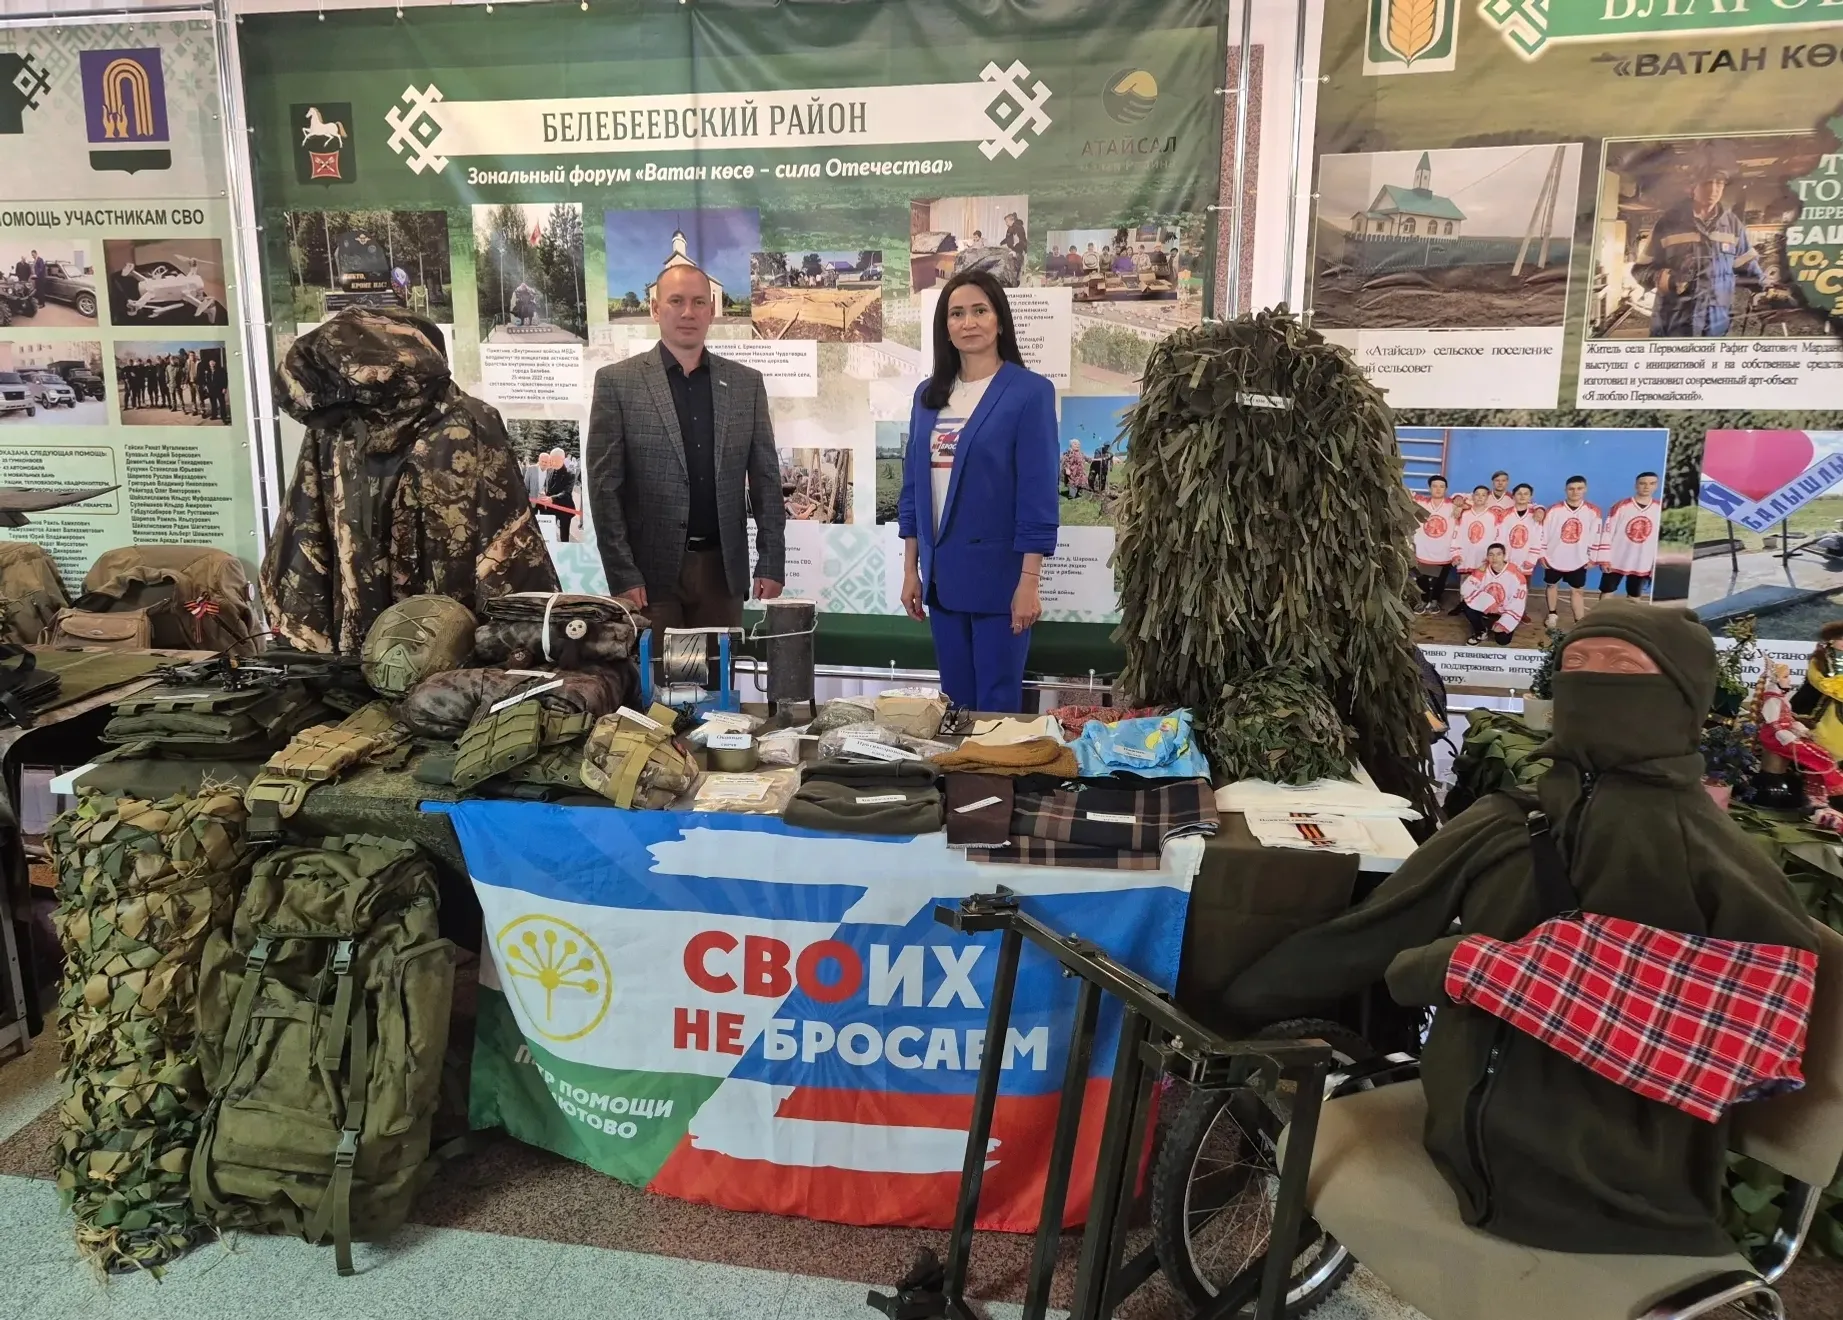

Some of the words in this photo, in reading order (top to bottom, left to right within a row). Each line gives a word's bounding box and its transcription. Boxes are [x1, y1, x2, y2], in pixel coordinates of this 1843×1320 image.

[1612, 47, 1767, 77] «ВАТАН
[1781, 43, 1843, 69] КӨ
[542, 100, 759, 143] БЕЛЕБЕЕВСКИЙ
[770, 97, 868, 136] РАЙОН
[1082, 135, 1177, 156] АТАЙСАЛ
[467, 166, 565, 184] Зональный
[569, 164, 630, 186] форум
[636, 164, 706, 182] «Ватан
[711, 164, 754, 180] көсө
[775, 162, 820, 178] сила
[826, 158, 953, 177] Отечества»
[1798, 179, 1843, 201] ГО
[0, 211, 61, 229] ОМОЩЬ
[64, 209, 167, 226] УЧАСТНИКАМ
[172, 209, 204, 225] СВО
[1787, 250, 1829, 269] ТО,
[1365, 345, 1426, 356] «Атайсал»
[1433, 347, 1484, 356] сельское
[1492, 347, 1553, 356] поселение
[1587, 344, 1621, 353] Житель
[1649, 343, 1716, 356] Первомайский
[1720, 343, 1748, 355] Рафит
[1378, 364, 1433, 373] сельсовет
[1585, 361, 1628, 372] выступил
[1646, 359, 1705, 370] инициативой
[1724, 361, 1735, 370] на
[1741, 358, 1800, 369] собственные
[1584, 377, 1628, 385] изготовил
[1638, 377, 1683, 387] установил
[1685, 376, 1746, 387] современный
[1748, 374, 1798, 387] арт-объект
[1596, 391, 1629, 401] люблю
[1699, 483, 1745, 517] Я
[1453, 652, 1507, 660] развивается
[1440, 663, 1504, 673] поддерживать
[683, 930, 986, 1009] СВОИХ
[673, 1007, 745, 1056] НЕ
[559, 1080, 674, 1119] ПОМОЩИ
[551, 1092, 638, 1139] ЮТОВО
